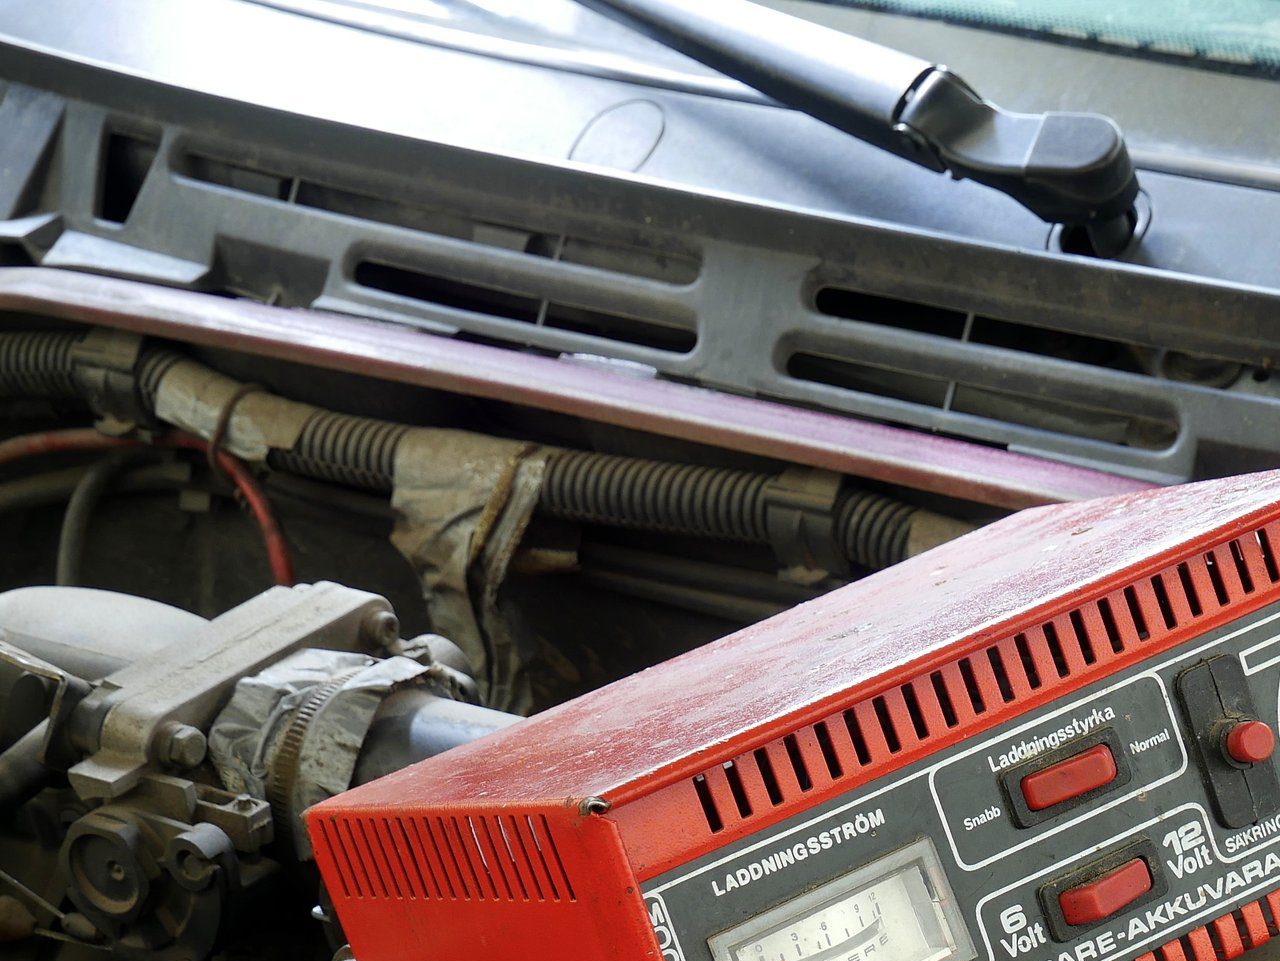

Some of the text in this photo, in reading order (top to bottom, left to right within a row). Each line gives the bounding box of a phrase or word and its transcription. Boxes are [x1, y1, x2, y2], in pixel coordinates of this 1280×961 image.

[988, 706, 1115, 772] Laddningsstyrka
[1129, 729, 1170, 755] Normal
[963, 806, 1001, 831] Snabb
[1163, 821, 1205, 852] 12
[712, 809, 885, 897] LADDNINGSSTRÖM
[1167, 847, 1213, 879] Volt
[791, 932, 799, 941] 3
[854, 904, 860, 913] 9
[1000, 904, 1027, 934] 6
[1000, 923, 1046, 958] Volt
